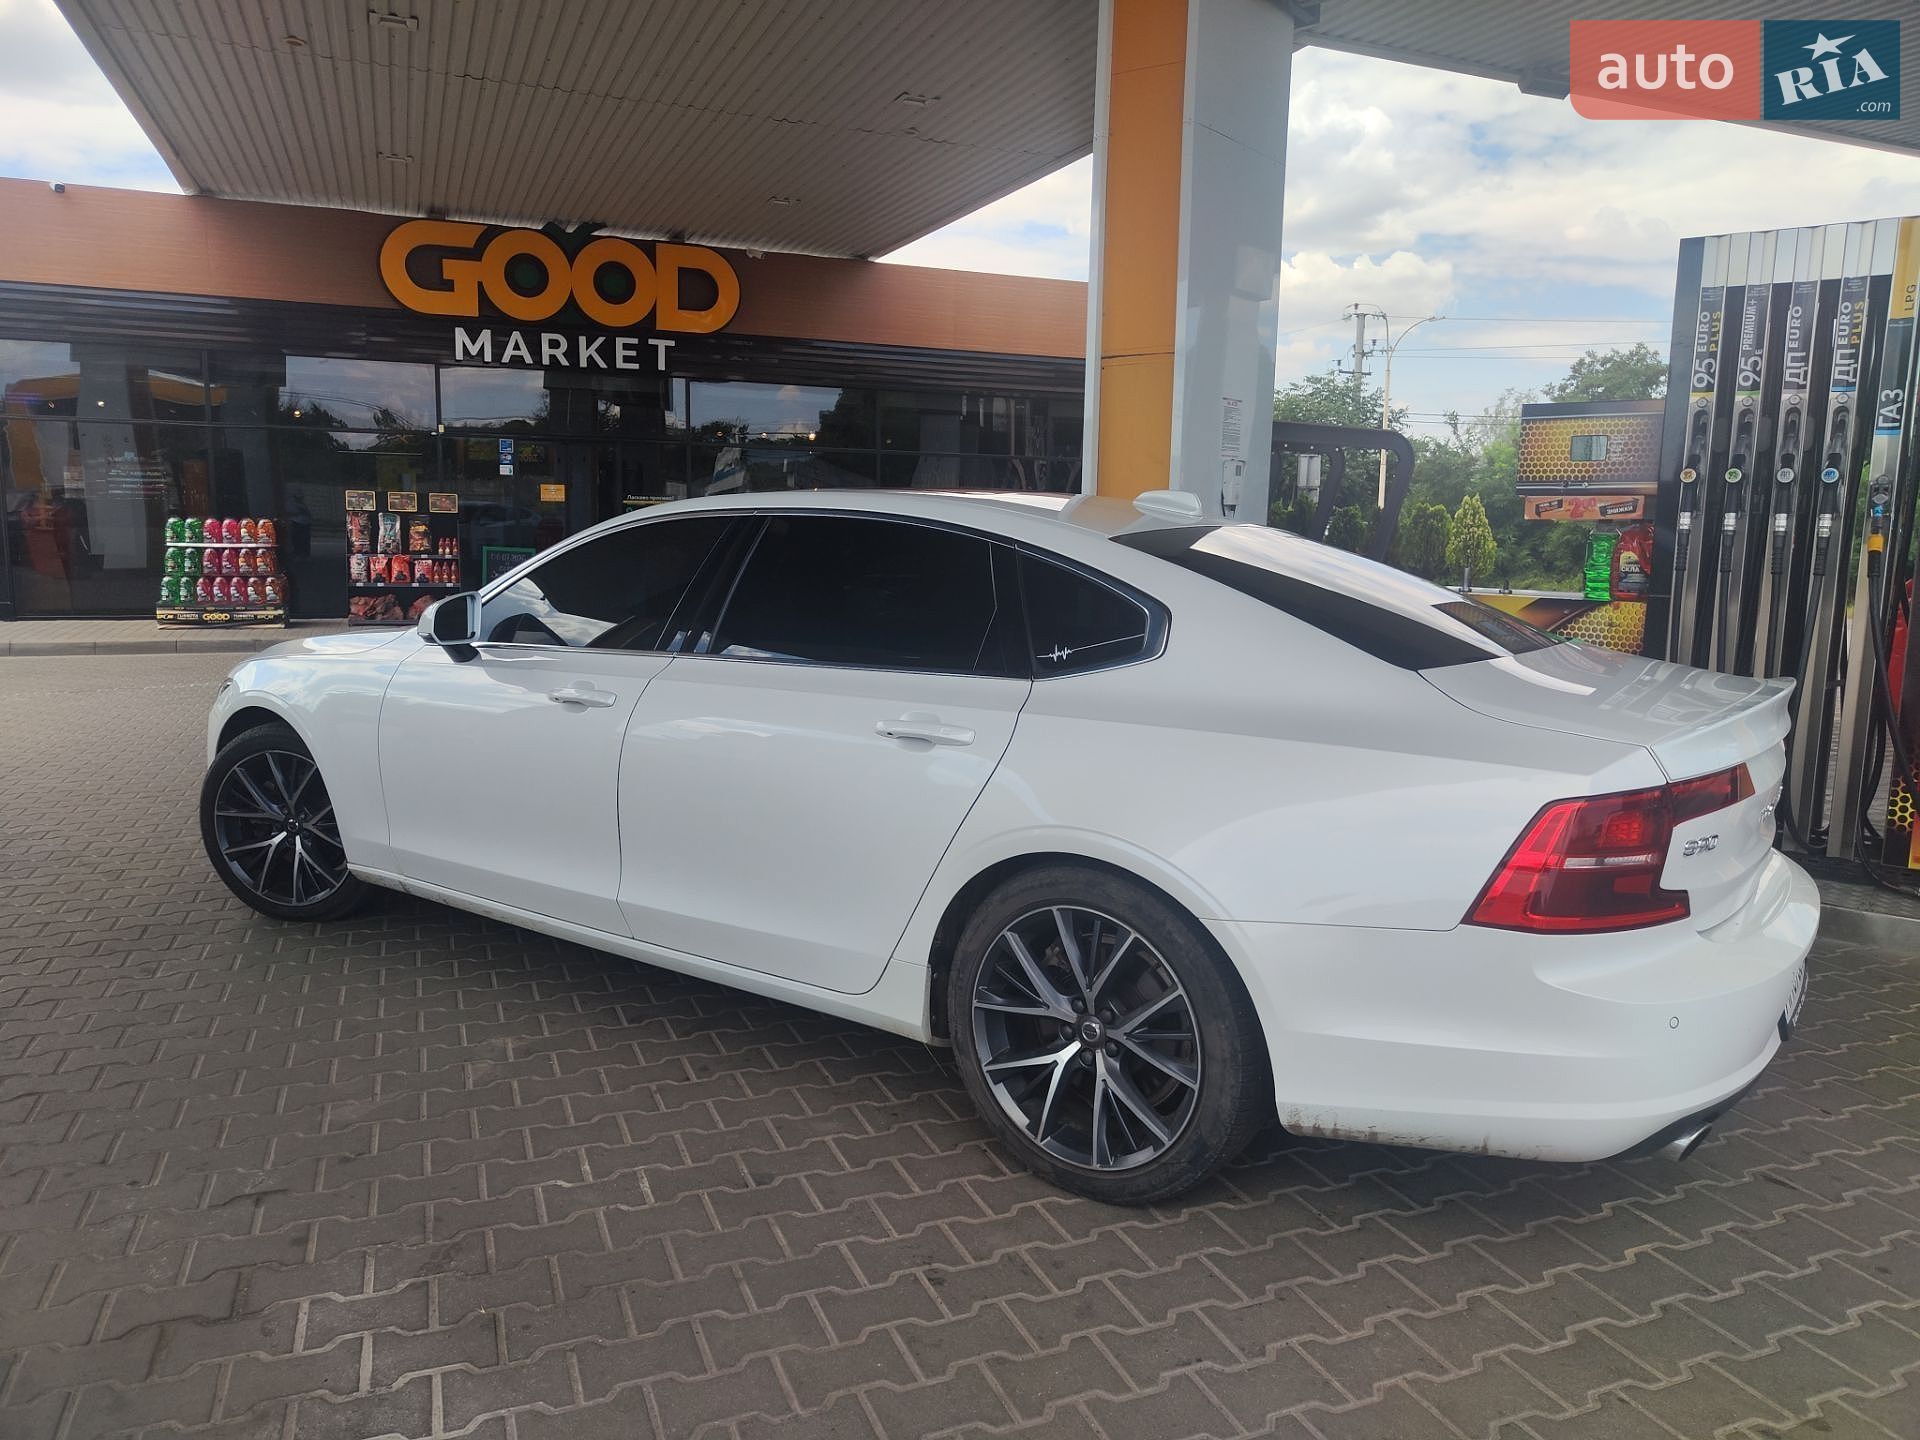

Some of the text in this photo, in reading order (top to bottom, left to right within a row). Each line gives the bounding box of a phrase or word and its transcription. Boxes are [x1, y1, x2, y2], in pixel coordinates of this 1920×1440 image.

[380, 220, 740, 334] GOOD
[1904, 284, 1917, 311] LPG
[1709, 311, 1721, 352] PLUS
[1834, 301, 1858, 383] ДП EURO
[1850, 301, 1865, 344] PLUS
[454, 326, 676, 371] MARKET
[1693, 311, 1716, 388] 95 EURO
[1785, 306, 1807, 385] ДП EURO
[1738, 355, 1762, 387] 95
[1878, 388, 1904, 428] ГАЗ
